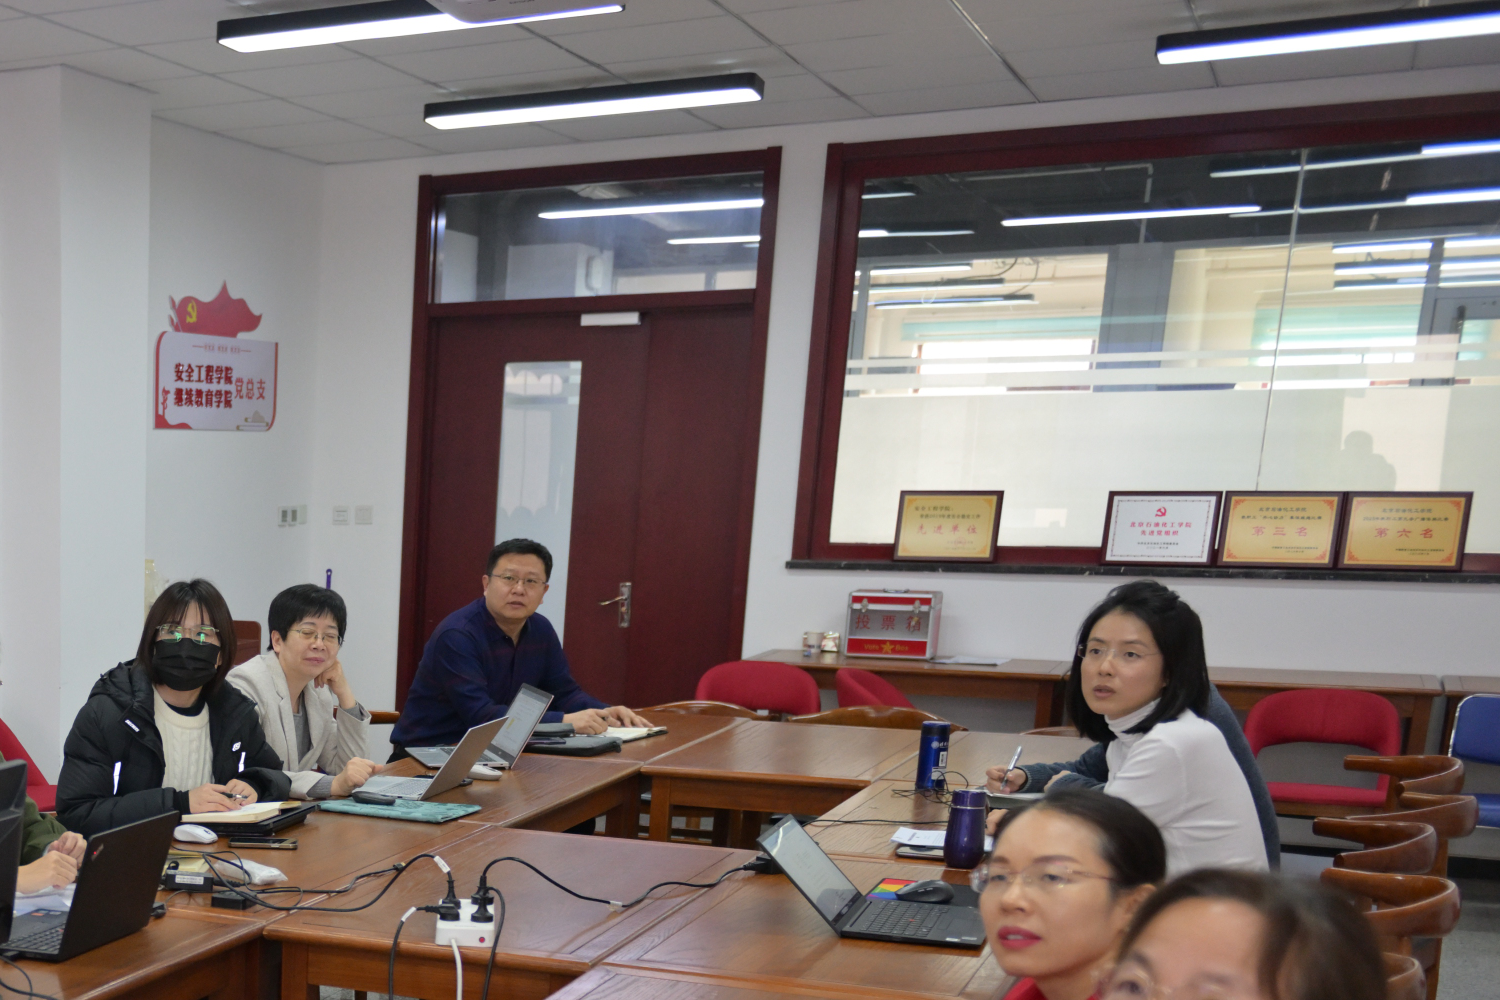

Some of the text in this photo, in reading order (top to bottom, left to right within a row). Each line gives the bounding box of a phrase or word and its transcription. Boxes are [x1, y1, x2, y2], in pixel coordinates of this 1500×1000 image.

[174, 363, 233, 384] 安全工程学院
[174, 388, 232, 408] 继续教育学院
[235, 378, 266, 400] 党总支
[917, 524, 977, 534] 先进单位
[1252, 526, 1307, 536] 第三名
[1375, 528, 1433, 538] 第六名
[855, 614, 921, 632] 投票箱
